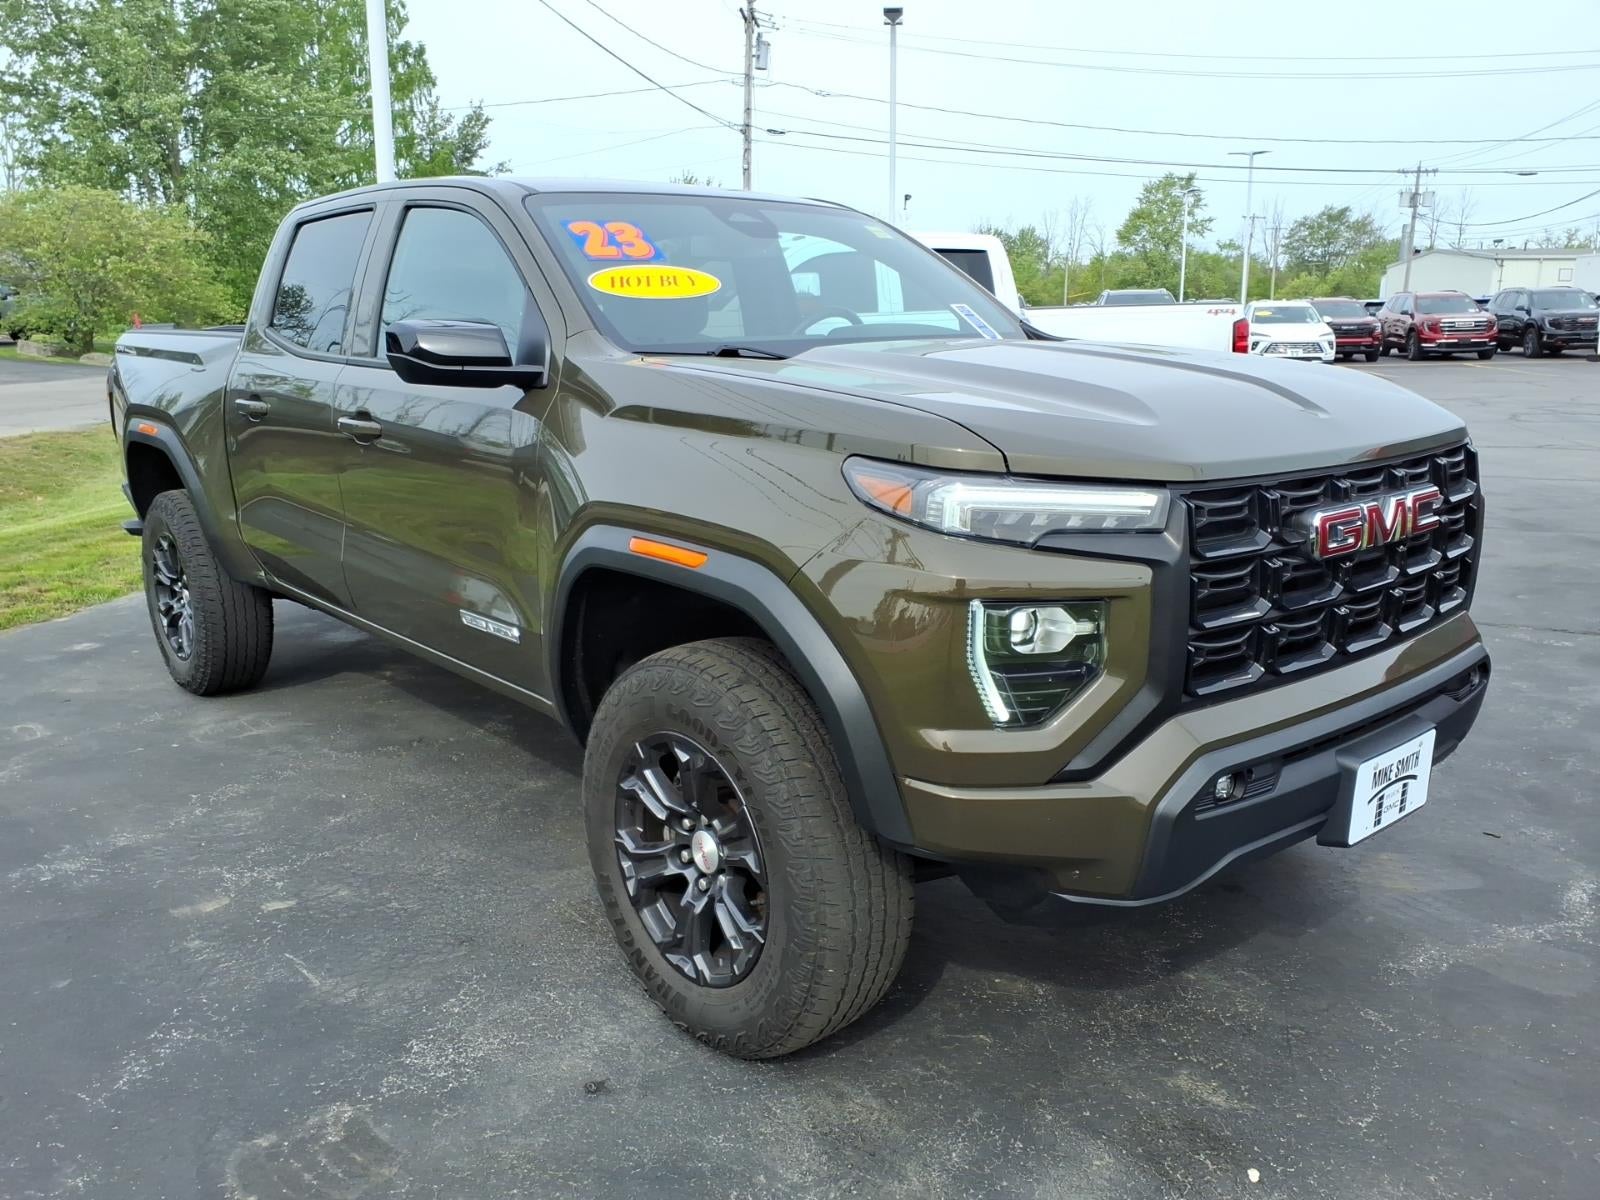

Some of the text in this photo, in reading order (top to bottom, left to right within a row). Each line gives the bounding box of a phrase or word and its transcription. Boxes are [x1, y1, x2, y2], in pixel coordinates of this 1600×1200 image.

[568, 220, 656, 260] 23
[610, 274, 697, 289] HOT BUY
[1311, 485, 1444, 561] GMC
[1371, 750, 1421, 790] MIKE SMITH
